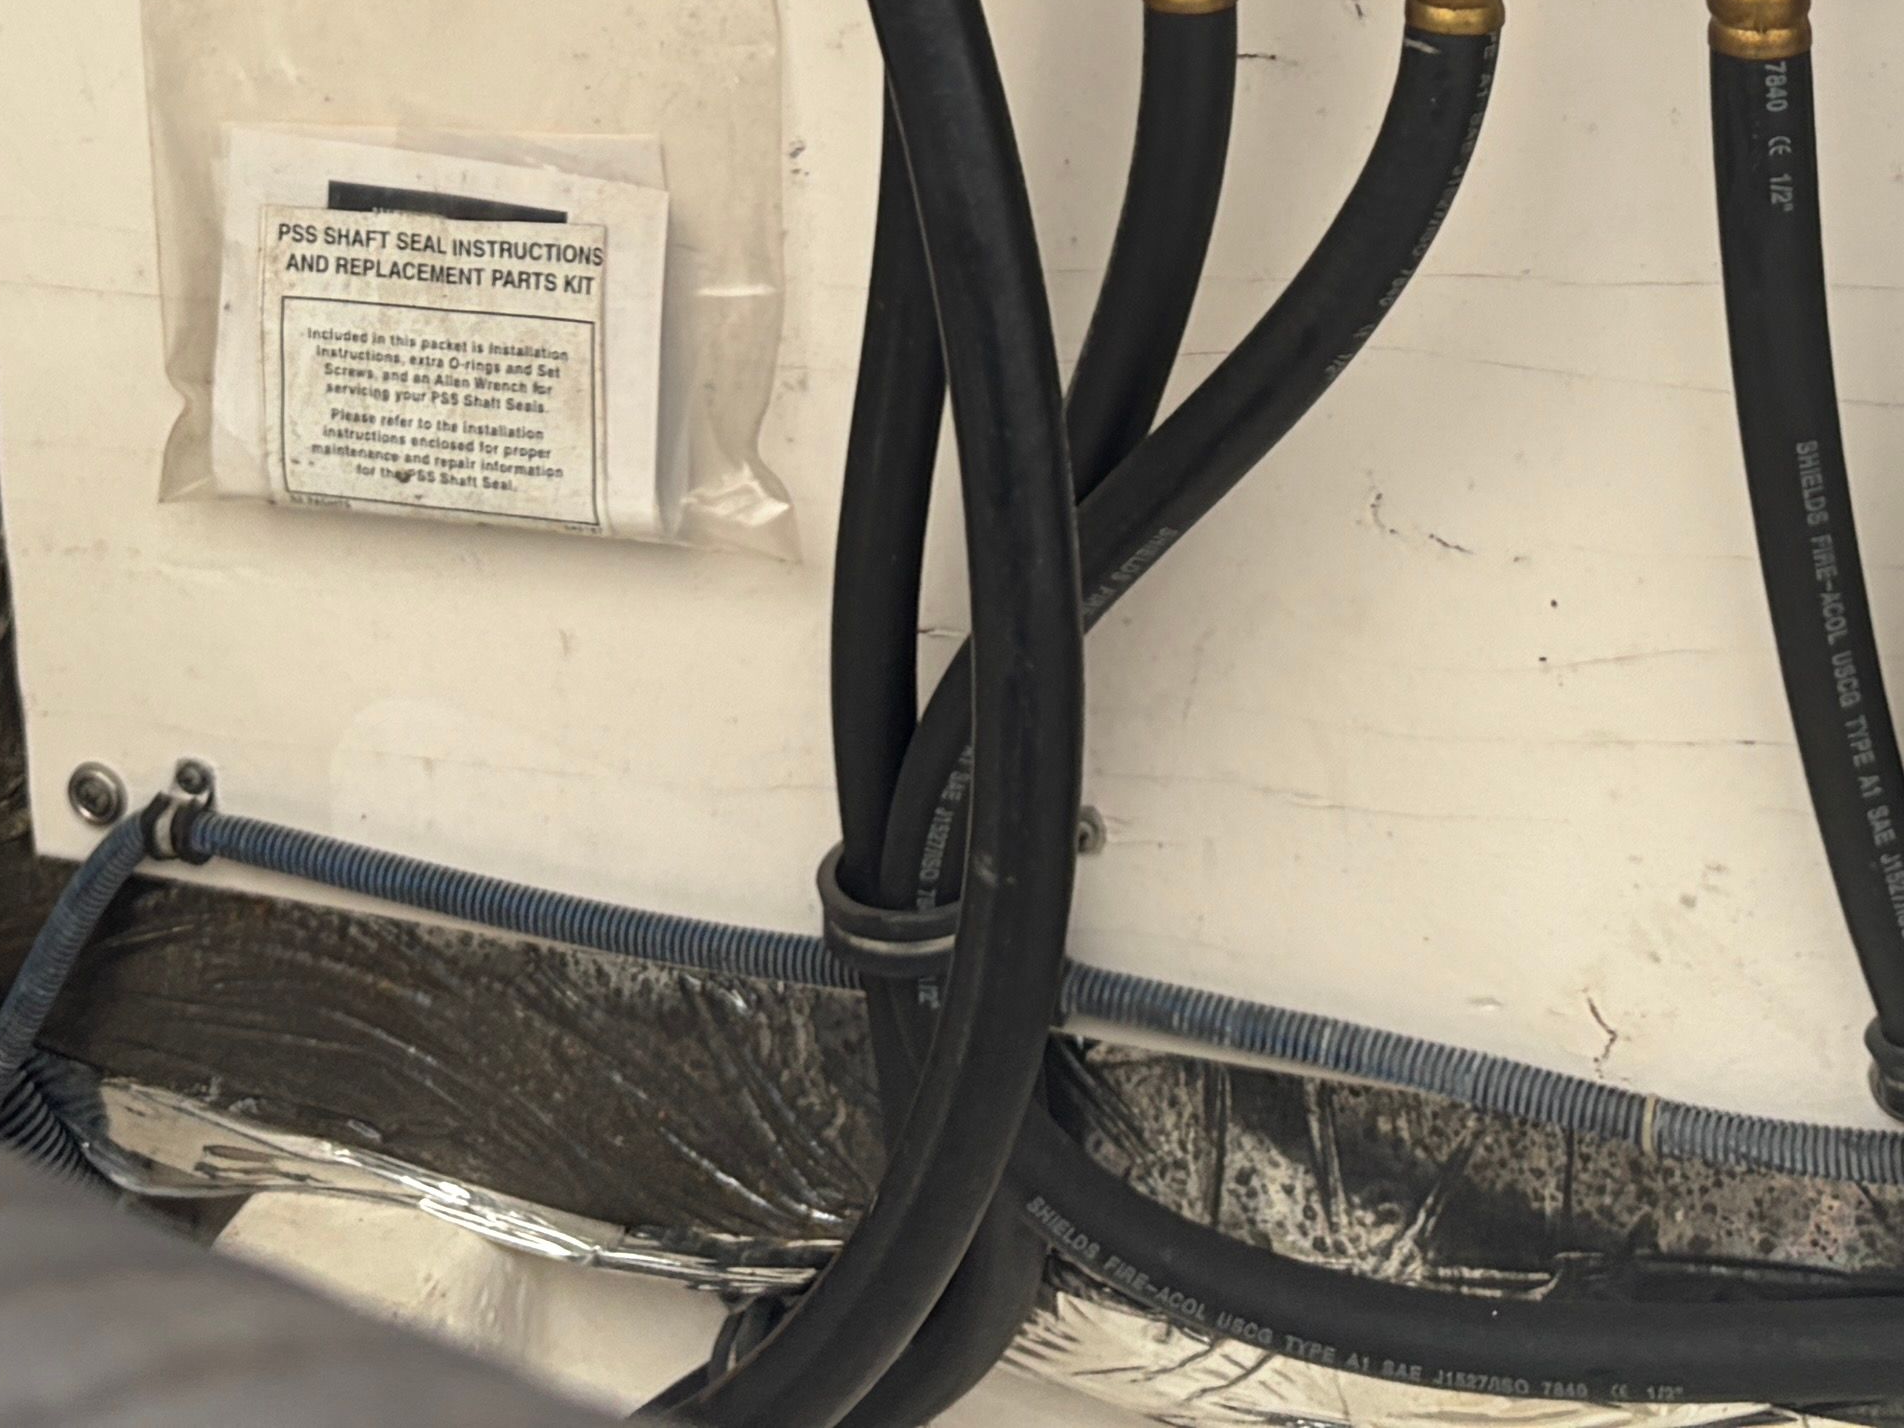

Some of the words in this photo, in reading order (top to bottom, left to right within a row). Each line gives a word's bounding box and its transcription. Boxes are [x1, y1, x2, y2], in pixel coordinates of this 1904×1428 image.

[1764, 61, 1789, 113] 7840
[277, 223, 318, 243] PSS
[324, 226, 391, 249] SHAFT
[395, 231, 446, 255] SEAL
[452, 238, 604, 267] INSTRUCTIONS
[286, 253, 329, 273] AND
[335, 256, 486, 287] REPLACEMENT
[491, 269, 557, 292] PARTS
[563, 275, 595, 295] KIT
[307, 327, 368, 344] Included
[371, 331, 386, 345] in
[390, 334, 417, 347] this
[421, 337, 467, 353] packet
[471, 340, 484, 354] is
[382, 370, 408, 383] and
[413, 373, 430, 385] an
[434, 373, 470, 389] Allen
[474, 376, 528, 393] Wrench
[532, 379, 553, 395] for
[409, 354, 444, 368] extra
[448, 356, 500, 375] O-rings
[505, 364, 533, 376] and
[537, 364, 560, 379] Set
[326, 383, 390, 402] servicing
[394, 390, 427, 403] your
[431, 390, 459, 406] PSS
[463, 393, 501, 410] Shaft
[330, 407, 376, 424] Please
[380, 414, 414, 427] refer
[416, 417, 432, 431] to
[436, 419, 458, 433] the
[311, 443, 399, 462] maintenance
[404, 454, 431, 465] and
[434, 456, 476, 470] repair
[480, 459, 564, 478] information
[411, 436, 475, 453] enclosed
[479, 441, 499, 455] for
[503, 445, 552, 461] proper
[356, 463, 376, 476] for
[439, 471, 477, 488] Shaft
[1796, 440, 1829, 527] SHIELDS
[1809, 533, 1849, 646] FIRE-ACOL
[1831, 650, 1862, 709] USCG
[1844, 713, 1877, 769] TYPE
[1858, 774, 1884, 799] A1
[1867, 804, 1897, 847] SAE
[1026, 1195, 1101, 1261] SHIELDS
[1103, 1255, 1207, 1321] FIRE-ACOL
[1216, 1311, 1274, 1347] USCG
[1285, 1334, 1338, 1364] TYPE
[1346, 1351, 1371, 1373] A1
[1382, 1359, 1423, 1383] SAE
